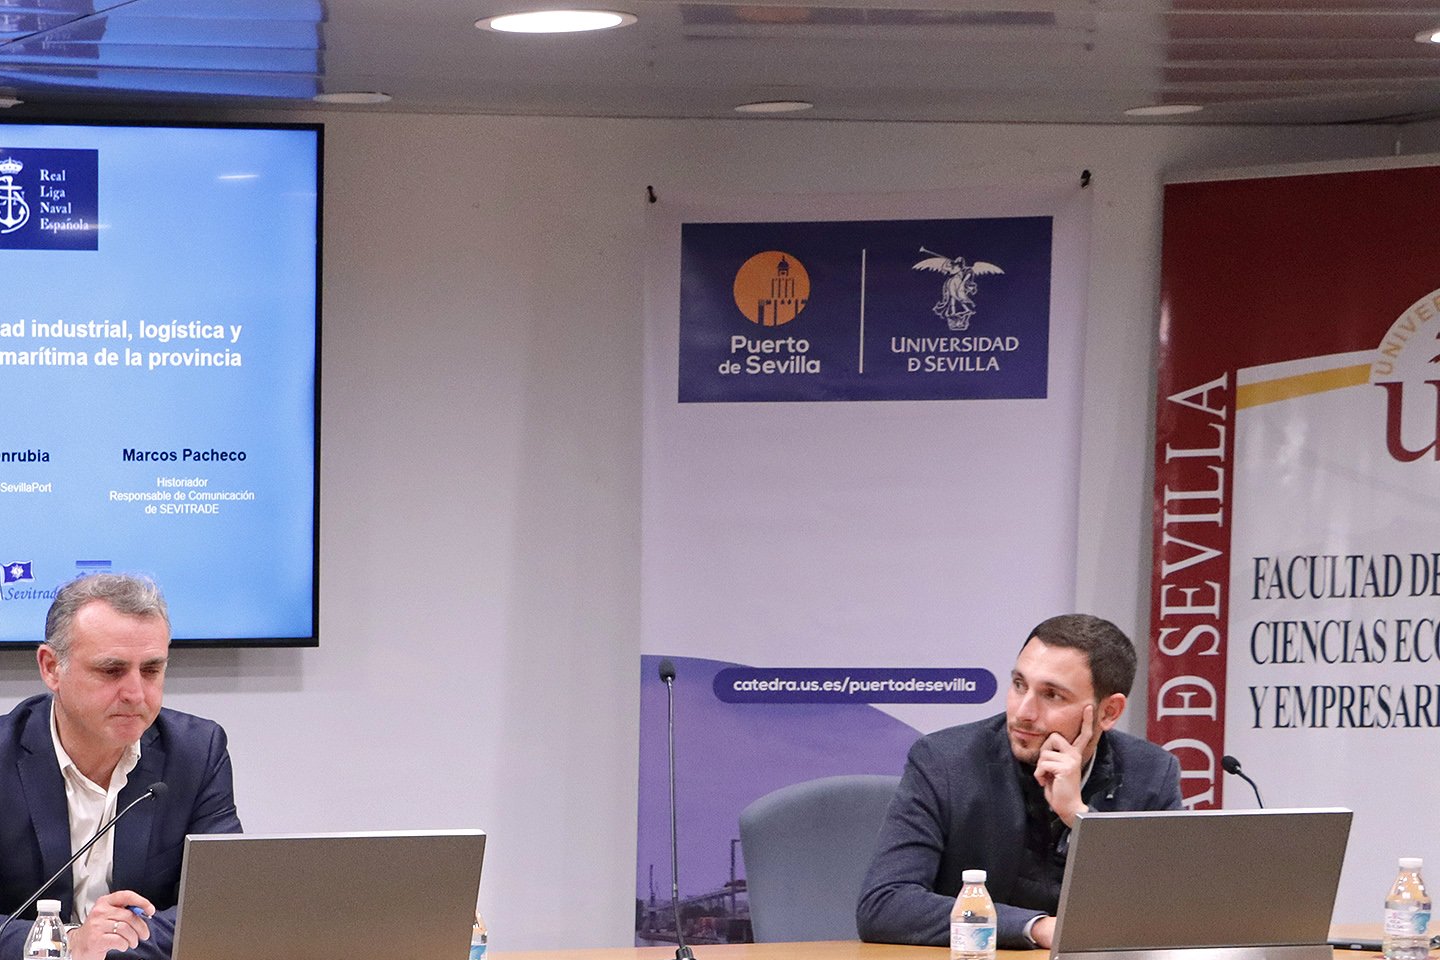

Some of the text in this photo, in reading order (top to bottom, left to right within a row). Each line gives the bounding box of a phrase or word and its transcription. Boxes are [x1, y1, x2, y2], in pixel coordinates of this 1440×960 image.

[40, 169, 66, 182] Real
[40, 185, 66, 199] Liga
[40, 202, 72, 214] Naval
[40, 217, 90, 232] Española
[31, 319, 133, 342] industrial,
[139, 319, 225, 343] logística
[230, 323, 242, 343] y
[731, 335, 810, 354] Puerto
[890, 336, 1020, 353] UNIVERSIDAD
[94, 348, 119, 366] de
[125, 348, 142, 366] la
[148, 348, 242, 370] provincia
[718, 356, 821, 375] de Sevilla
[924, 355, 1000, 372] SEVILLA
[122, 449, 247, 462] Marcos Pacheco
[157, 477, 208, 488] Historiador
[110, 489, 255, 503] Responsable de Comunicación
[144, 503, 220, 514] de SEVITRADE
[1158, 371, 1228, 657] SEVILLA
[1251, 554, 1403, 600] FACULTAD
[5, 587, 59, 601] Sevitrad
[1250, 618, 1387, 664] CIENCIAS
[733, 677, 977, 695] catedra.us.es/puertodesevilla
[1249, 686, 1268, 729] Y
